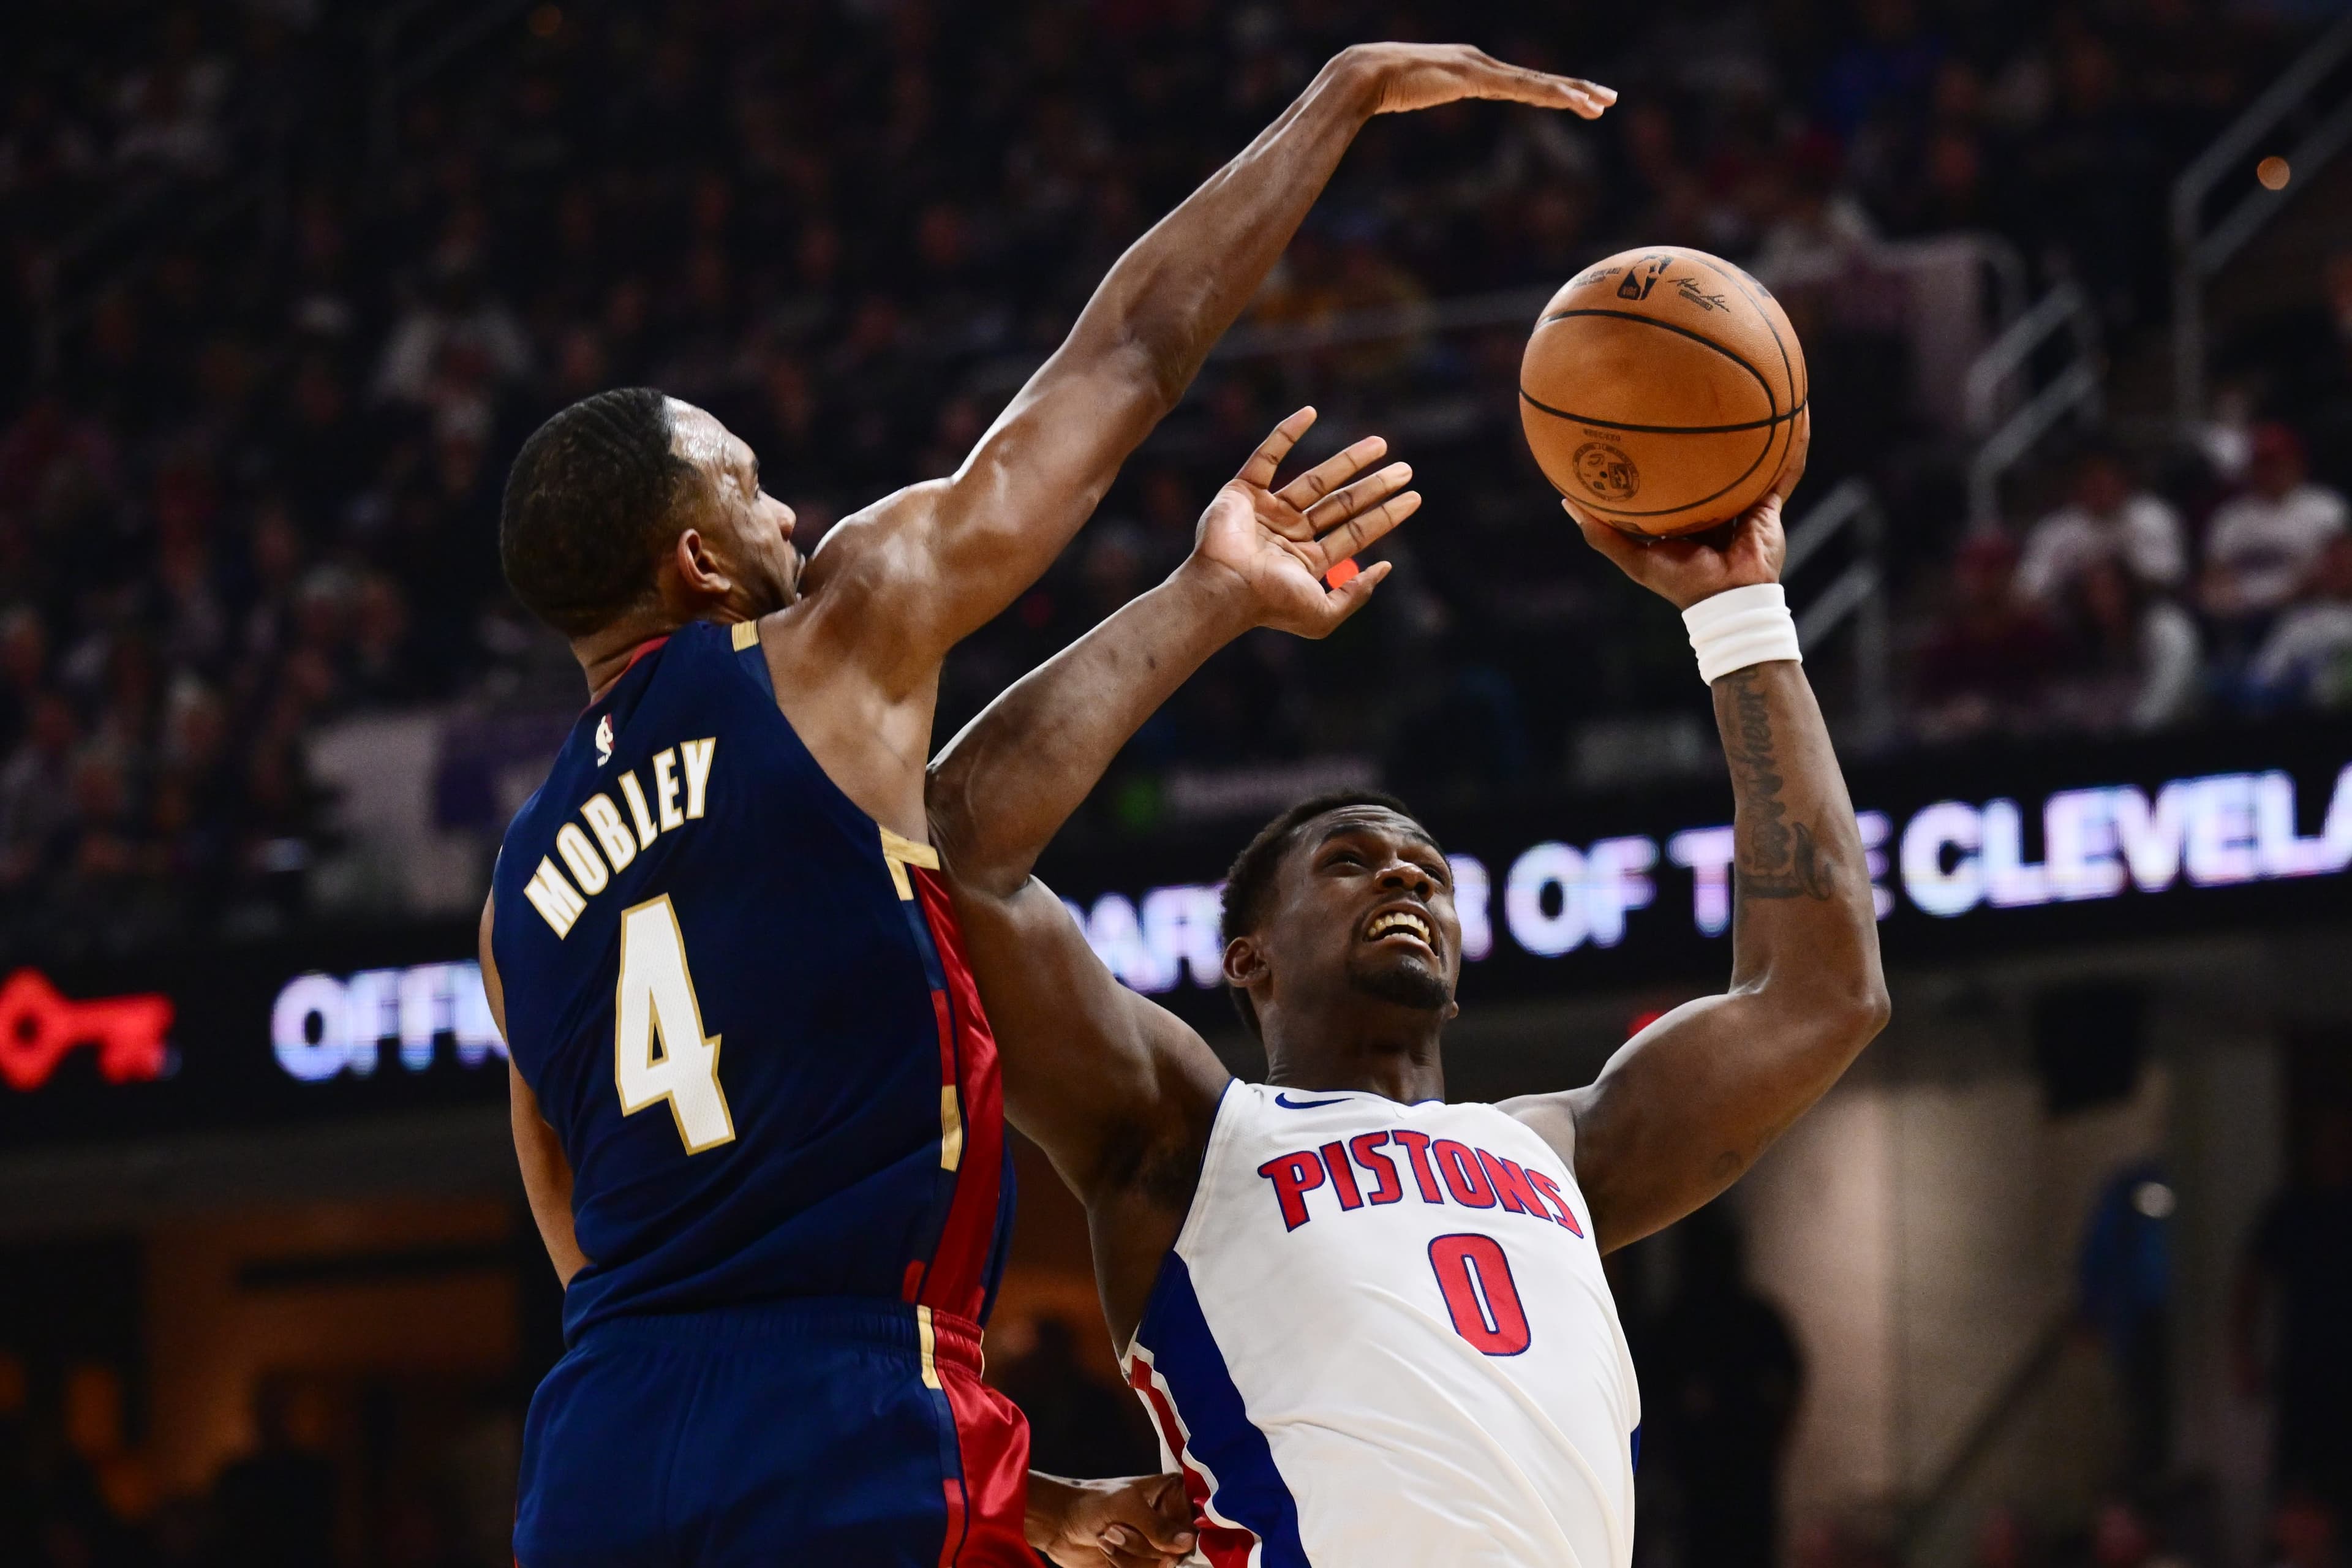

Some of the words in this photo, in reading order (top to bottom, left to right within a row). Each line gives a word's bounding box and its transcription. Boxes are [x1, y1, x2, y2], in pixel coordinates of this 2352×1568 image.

[523, 736, 716, 941] MOBLEY
[270, 959, 510, 1084] OFFI
[1504, 839, 1660, 959] OF
[614, 892, 736, 1156] 4
[1257, 1129, 1585, 1234] PISTONS
[1427, 1232, 1532, 1357] 0
